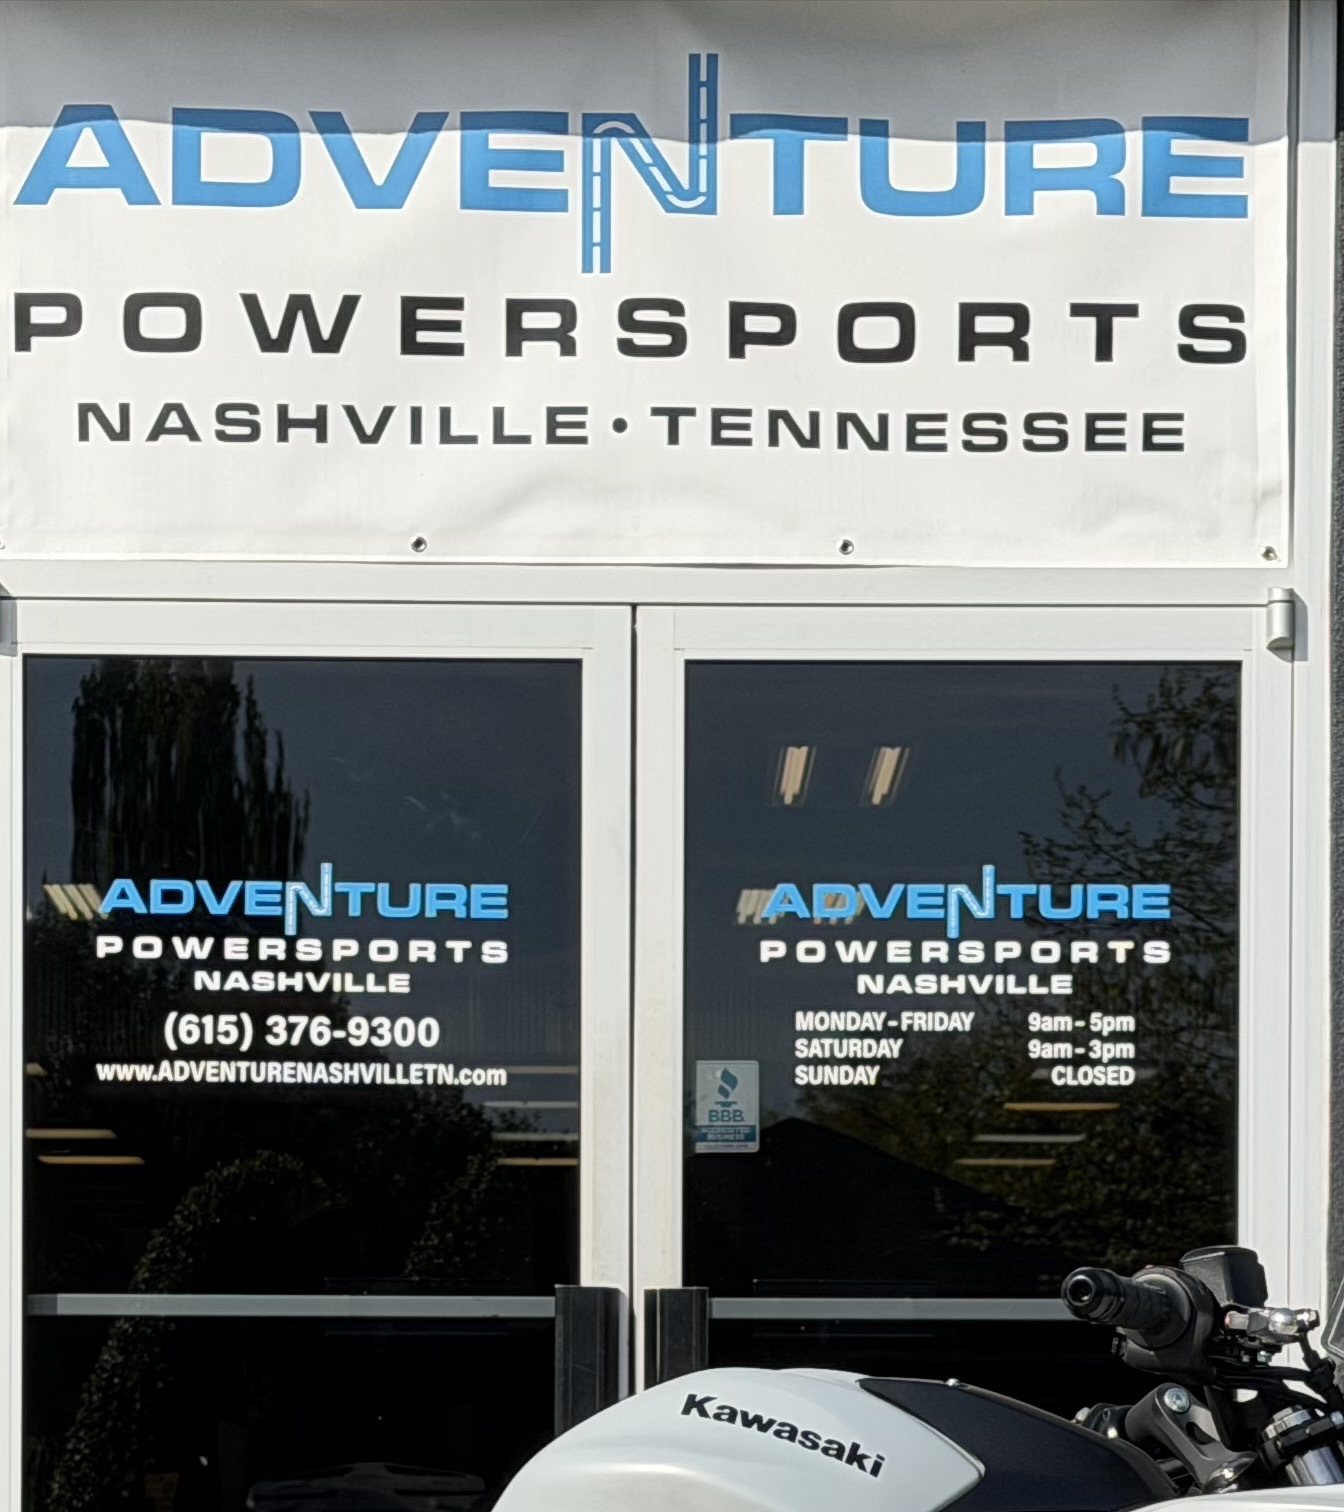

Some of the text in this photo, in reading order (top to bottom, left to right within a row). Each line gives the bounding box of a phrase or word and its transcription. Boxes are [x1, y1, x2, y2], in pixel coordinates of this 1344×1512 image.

[13, 53, 1250, 274] ADVENTURE
[13, 291, 1248, 364] POWERSPORTS
[77, 402, 1186, 454] NASHVILLE TENNESSEE
[98, 862, 509, 936] ADVENTURE
[761, 864, 1172, 938] ADVENTURE
[95, 935, 509, 964] POWERSPORTS
[759, 939, 1172, 964] POWERSPORTS
[193, 970, 411, 994] NASHVILLE
[856, 973, 1074, 996] NASHVILLE
[163, 1010, 441, 1052] (615) 376-9300
[794, 1037, 904, 1059] SATURDAY
[95, 1061, 508, 1087] www.ADVENTURENASHVILLETN.com
[794, 1064, 1136, 1087] SUNDAY CLOSED
[708, 1109, 744, 1122] BBB
[680, 1393, 887, 1479] Kawasaki
